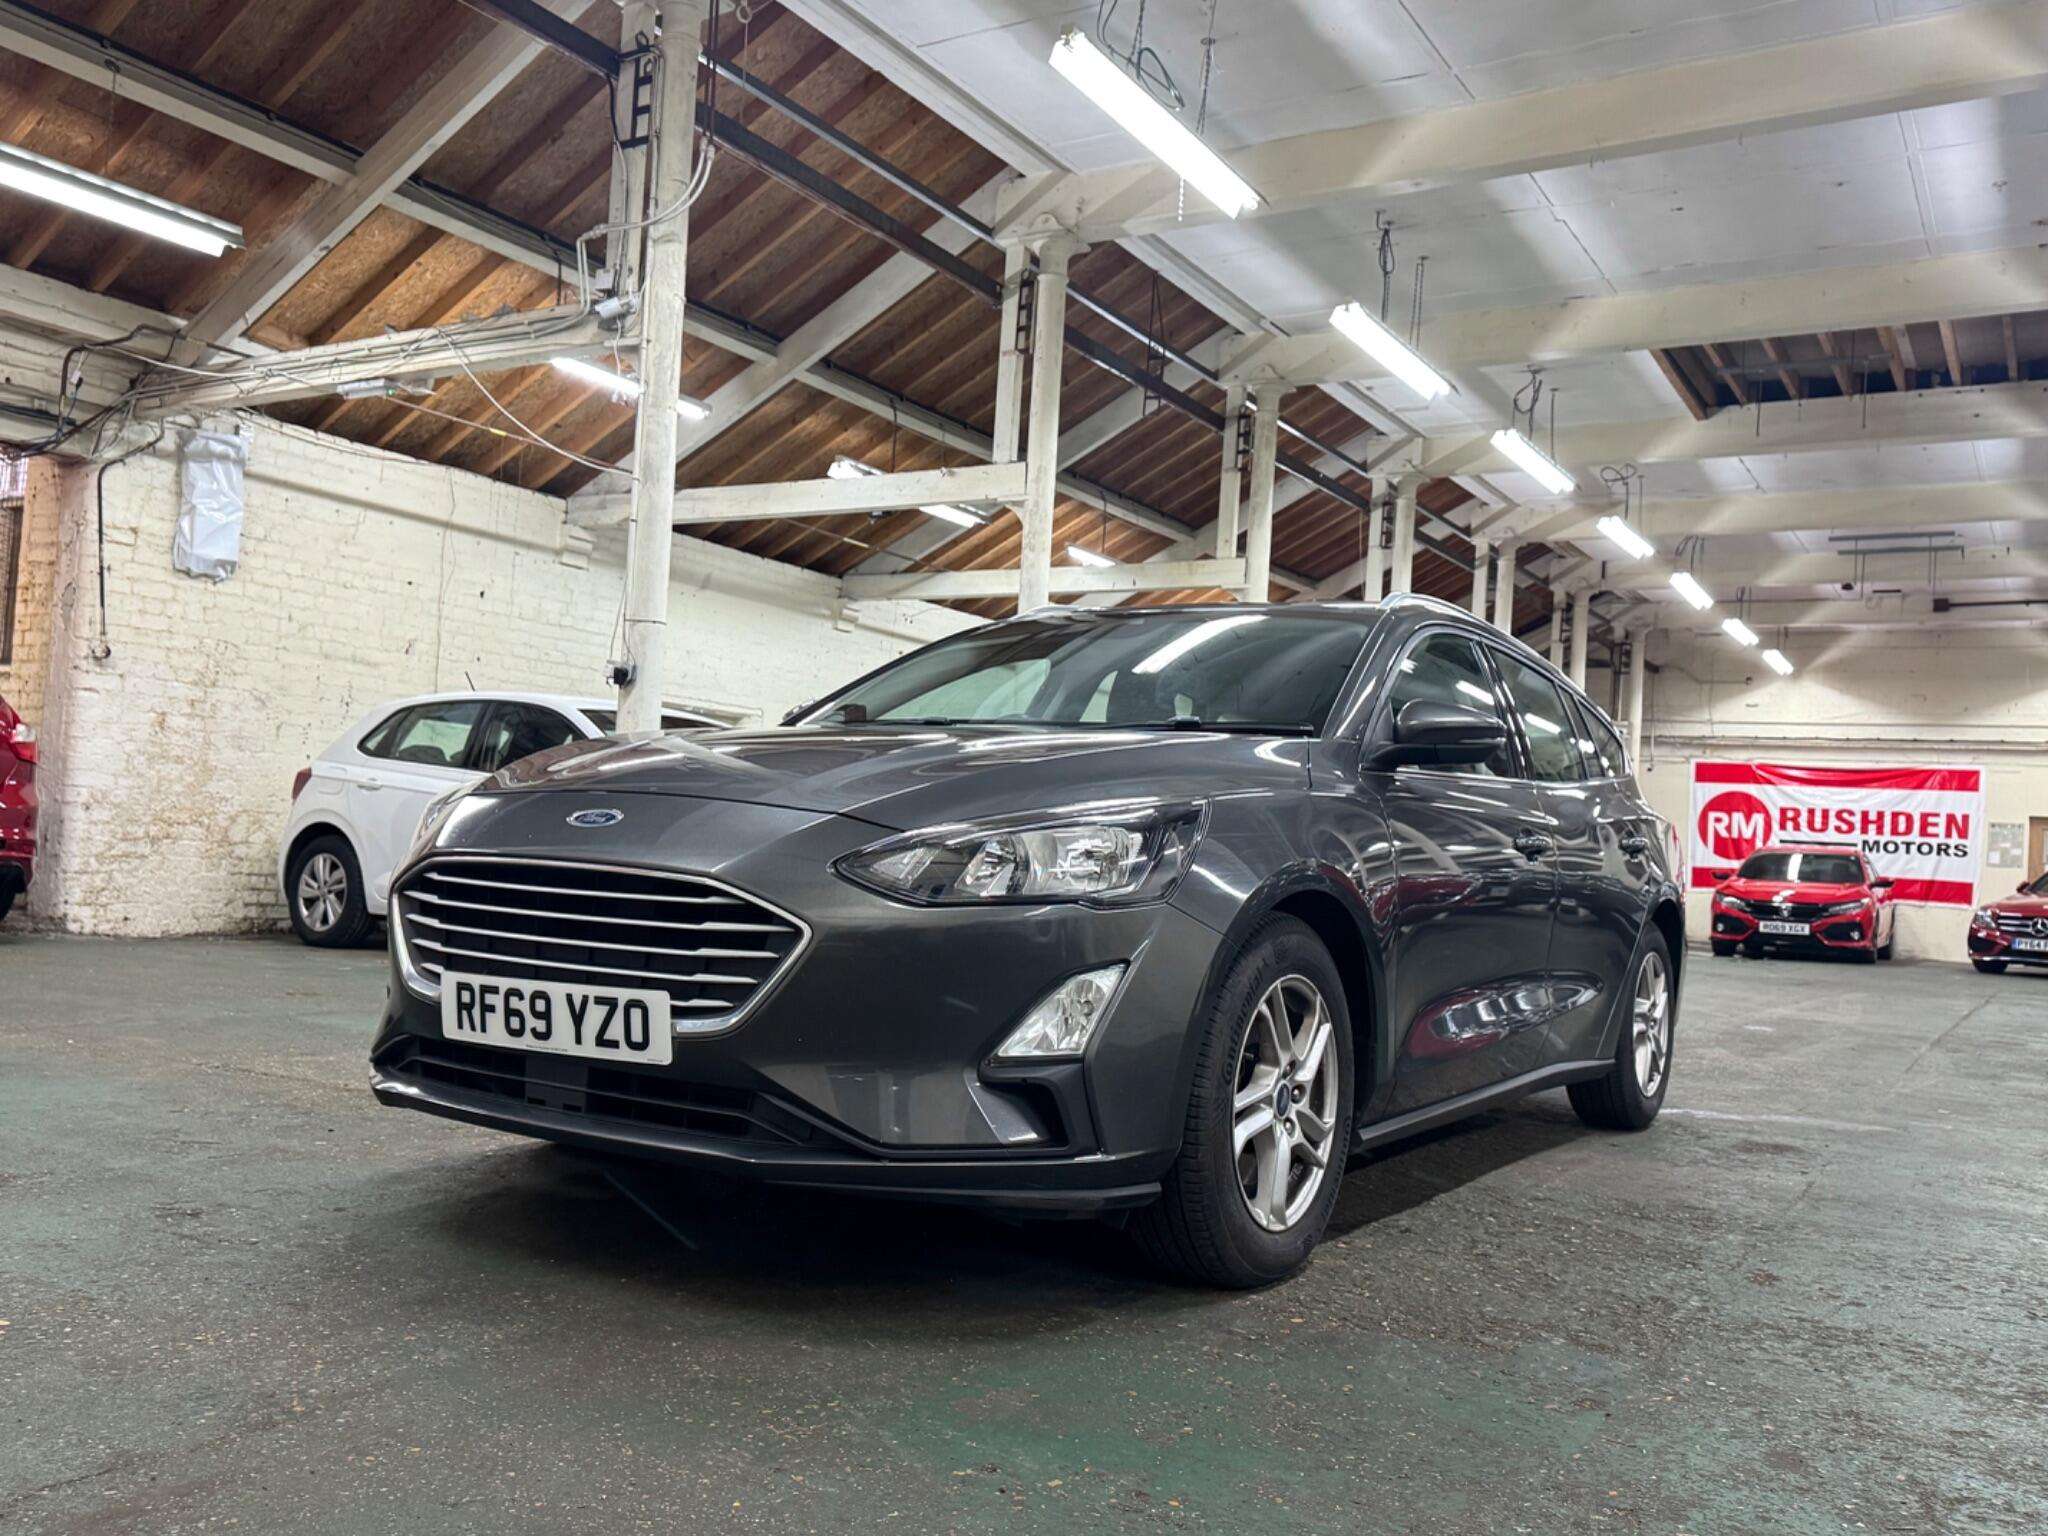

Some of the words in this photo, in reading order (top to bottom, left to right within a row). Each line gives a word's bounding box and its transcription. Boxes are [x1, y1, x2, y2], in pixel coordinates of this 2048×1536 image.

[1708, 811, 1765, 848] RM
[1779, 806, 1971, 840] RUSHDEN
[1861, 840, 1969, 858] MOTORS
[455, 981, 553, 1042] RF69
[566, 992, 650, 1051] YZO
